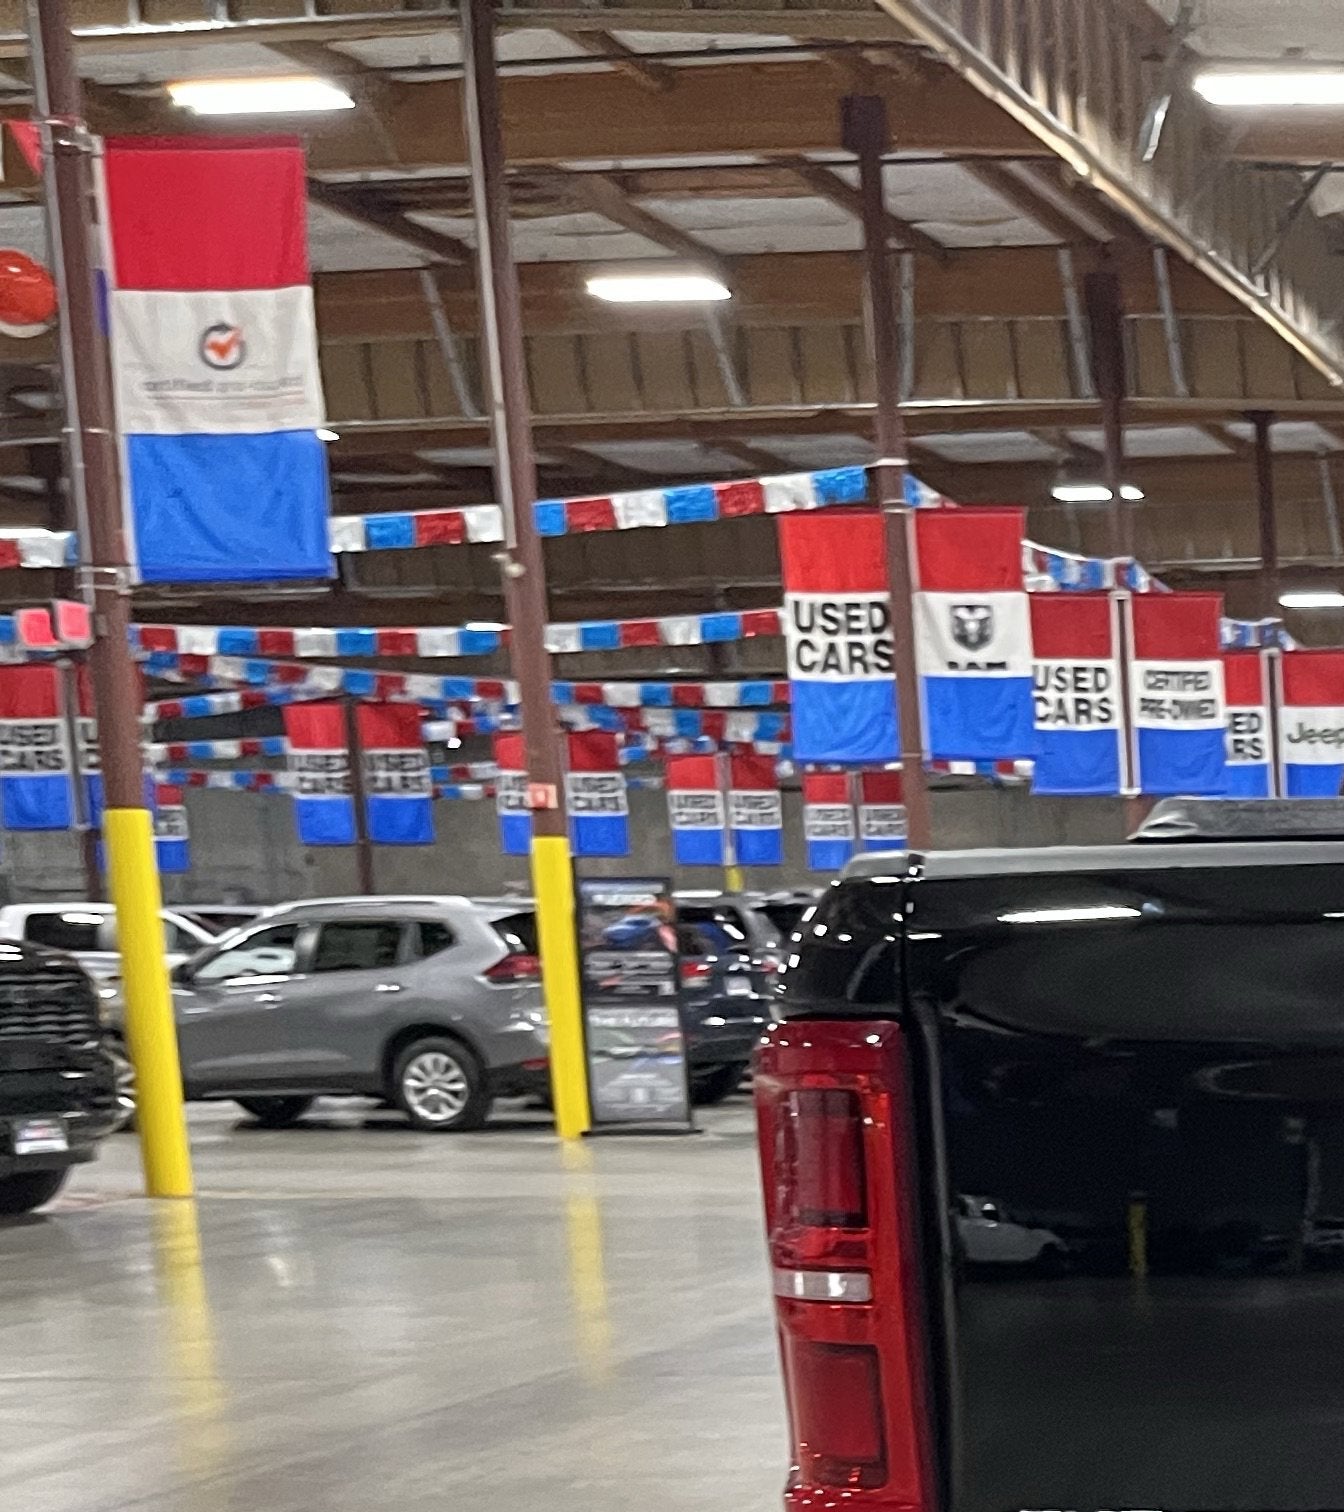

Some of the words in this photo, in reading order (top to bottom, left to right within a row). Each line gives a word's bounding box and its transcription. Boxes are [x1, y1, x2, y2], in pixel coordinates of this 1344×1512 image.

[793, 601, 891, 635] USED
[796, 638, 894, 673] CARS
[1033, 665, 1111, 693] USED
[1034, 697, 1113, 724] CARS
